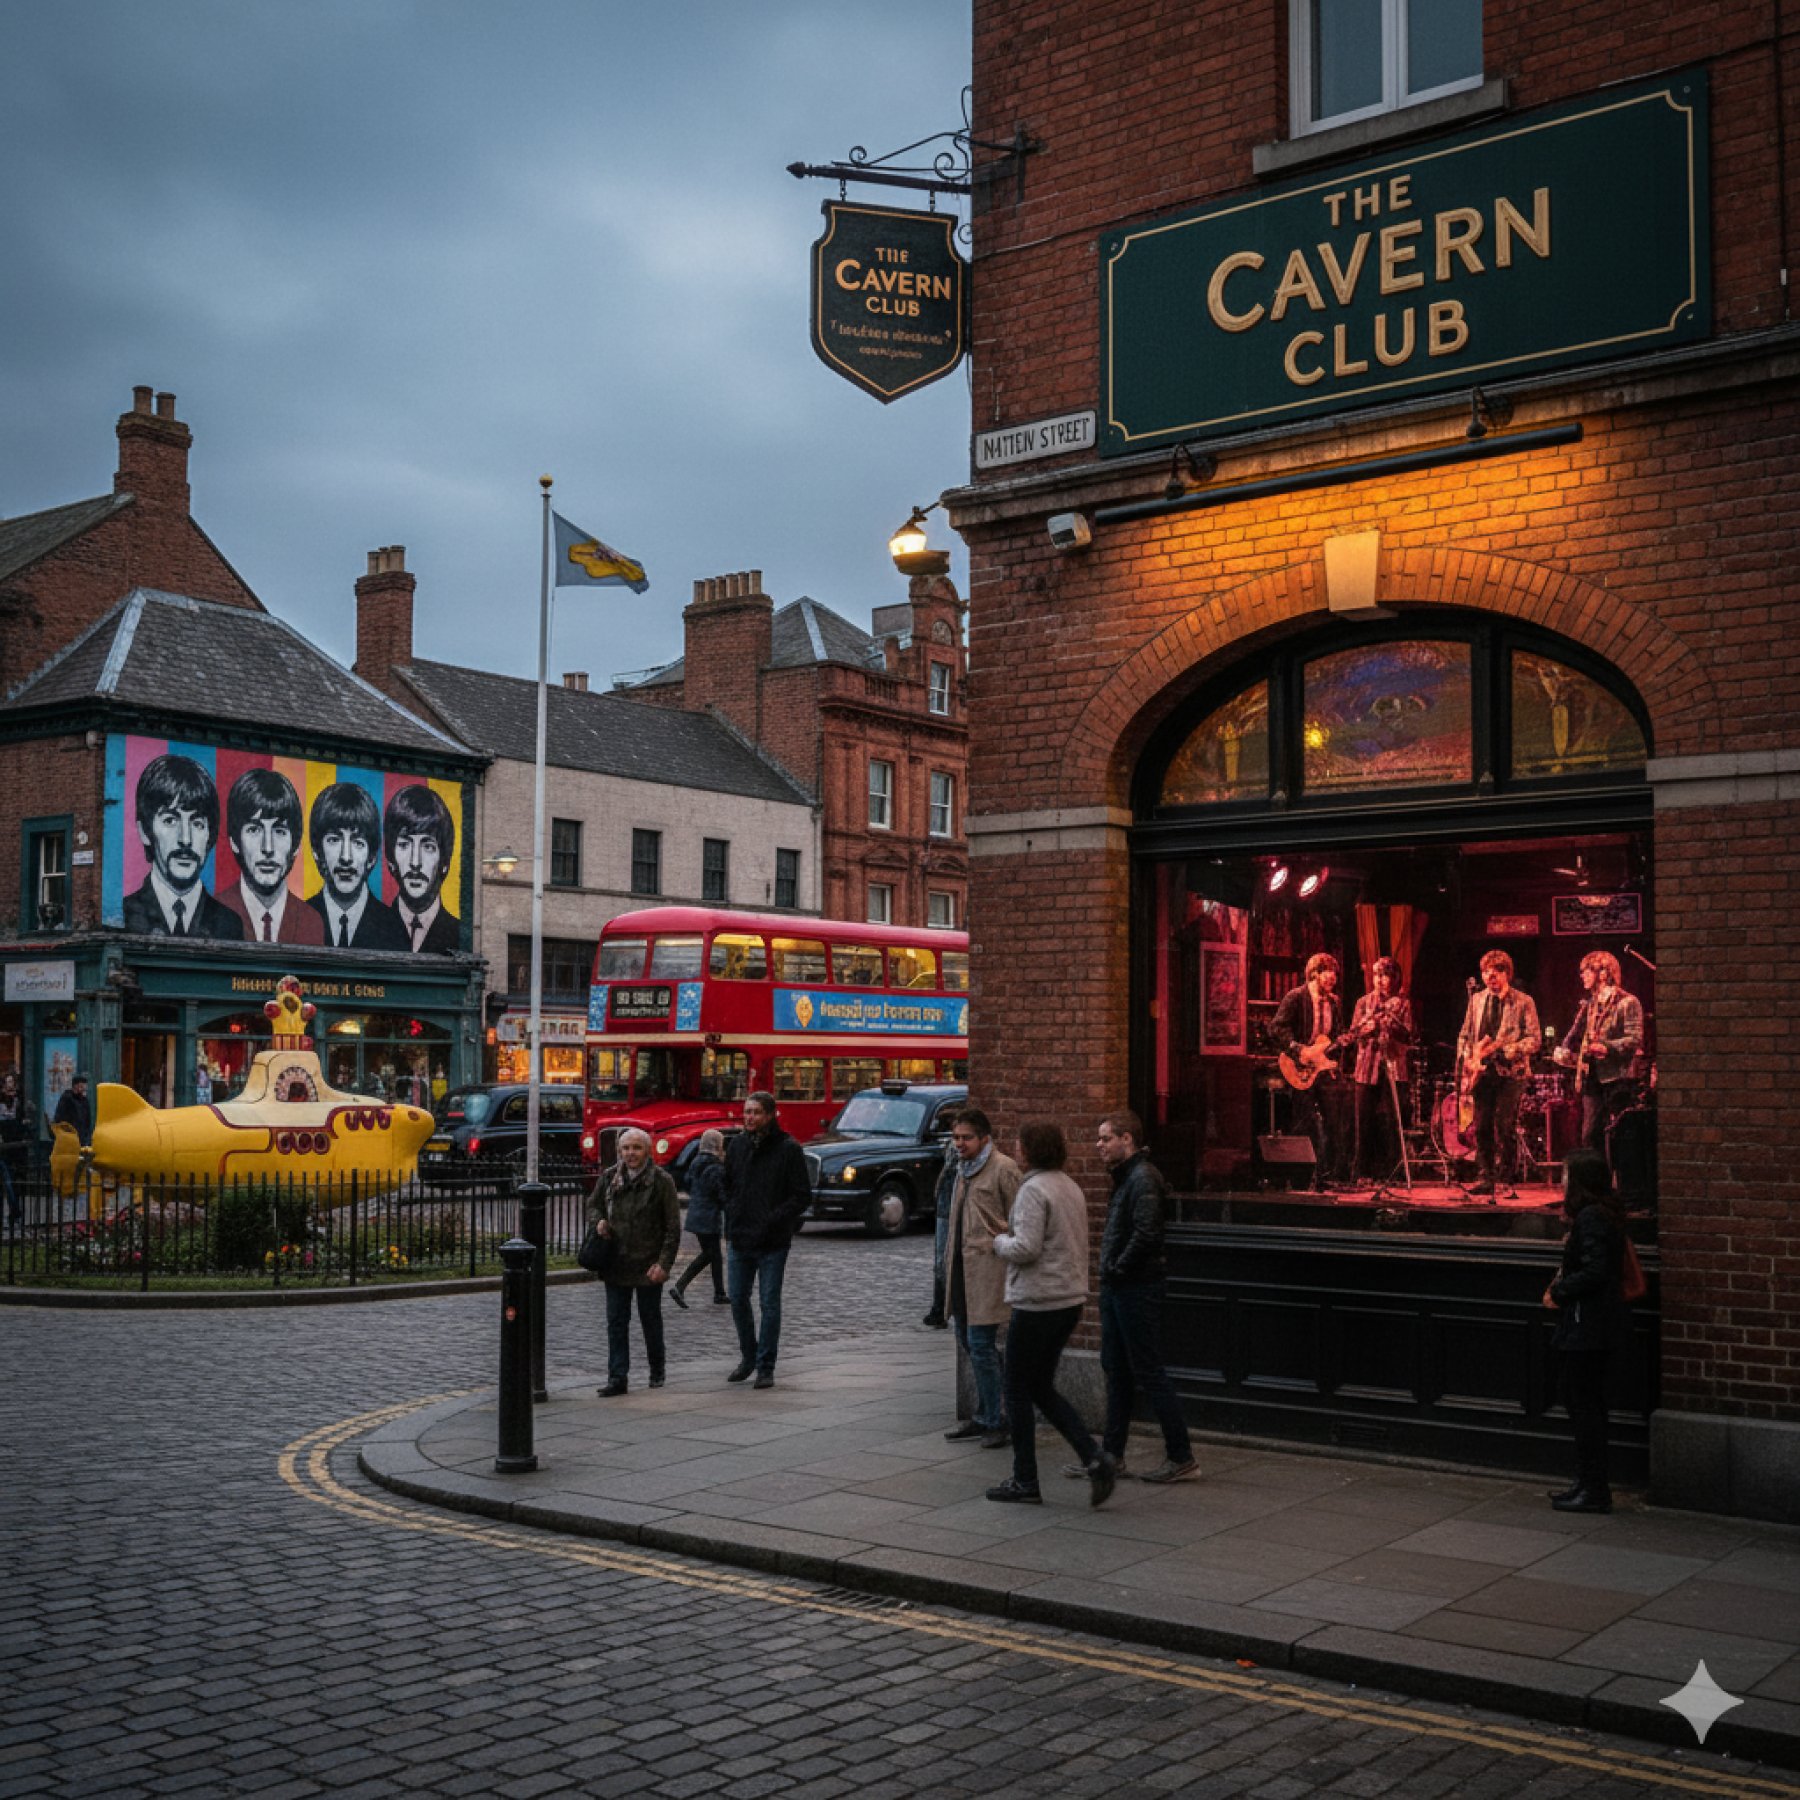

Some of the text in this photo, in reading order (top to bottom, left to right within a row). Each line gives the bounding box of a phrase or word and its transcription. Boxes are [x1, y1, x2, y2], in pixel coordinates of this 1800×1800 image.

[1323, 174, 1413, 227] THE
[835, 258, 952, 300] CAVERN
[1206, 187, 1551, 333] CAVERN
[865, 296, 920, 317] CLUB
[1283, 299, 1470, 386] CLUB
[1040, 417, 1090, 449] STREET
